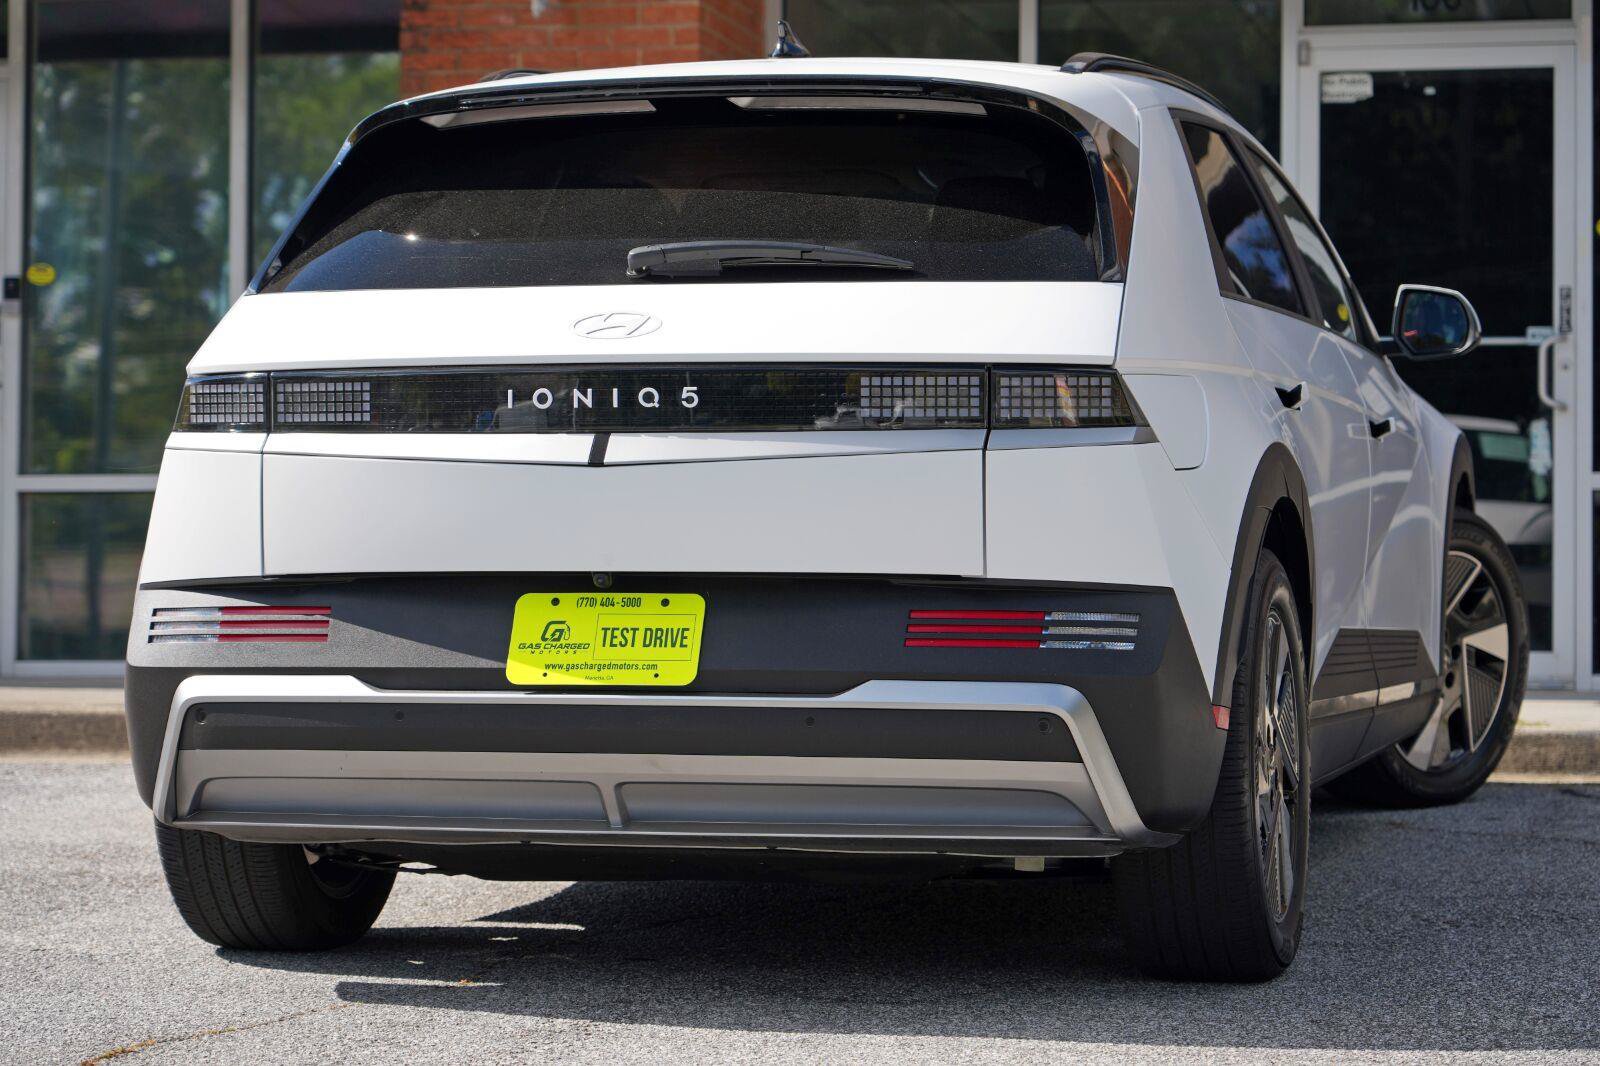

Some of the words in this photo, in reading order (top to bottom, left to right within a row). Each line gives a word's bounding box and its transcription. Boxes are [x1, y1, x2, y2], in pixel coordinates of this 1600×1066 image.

[507, 387, 659, 409] IONIQ
[681, 386, 699, 409] 5
[576, 597, 598, 609] (770)
[599, 597, 642, 608] 404-5000
[601, 627, 640, 648] TEST
[642, 627, 690, 648] DRIVE
[544, 661, 658, 672] www.gaschargedmotors.com
